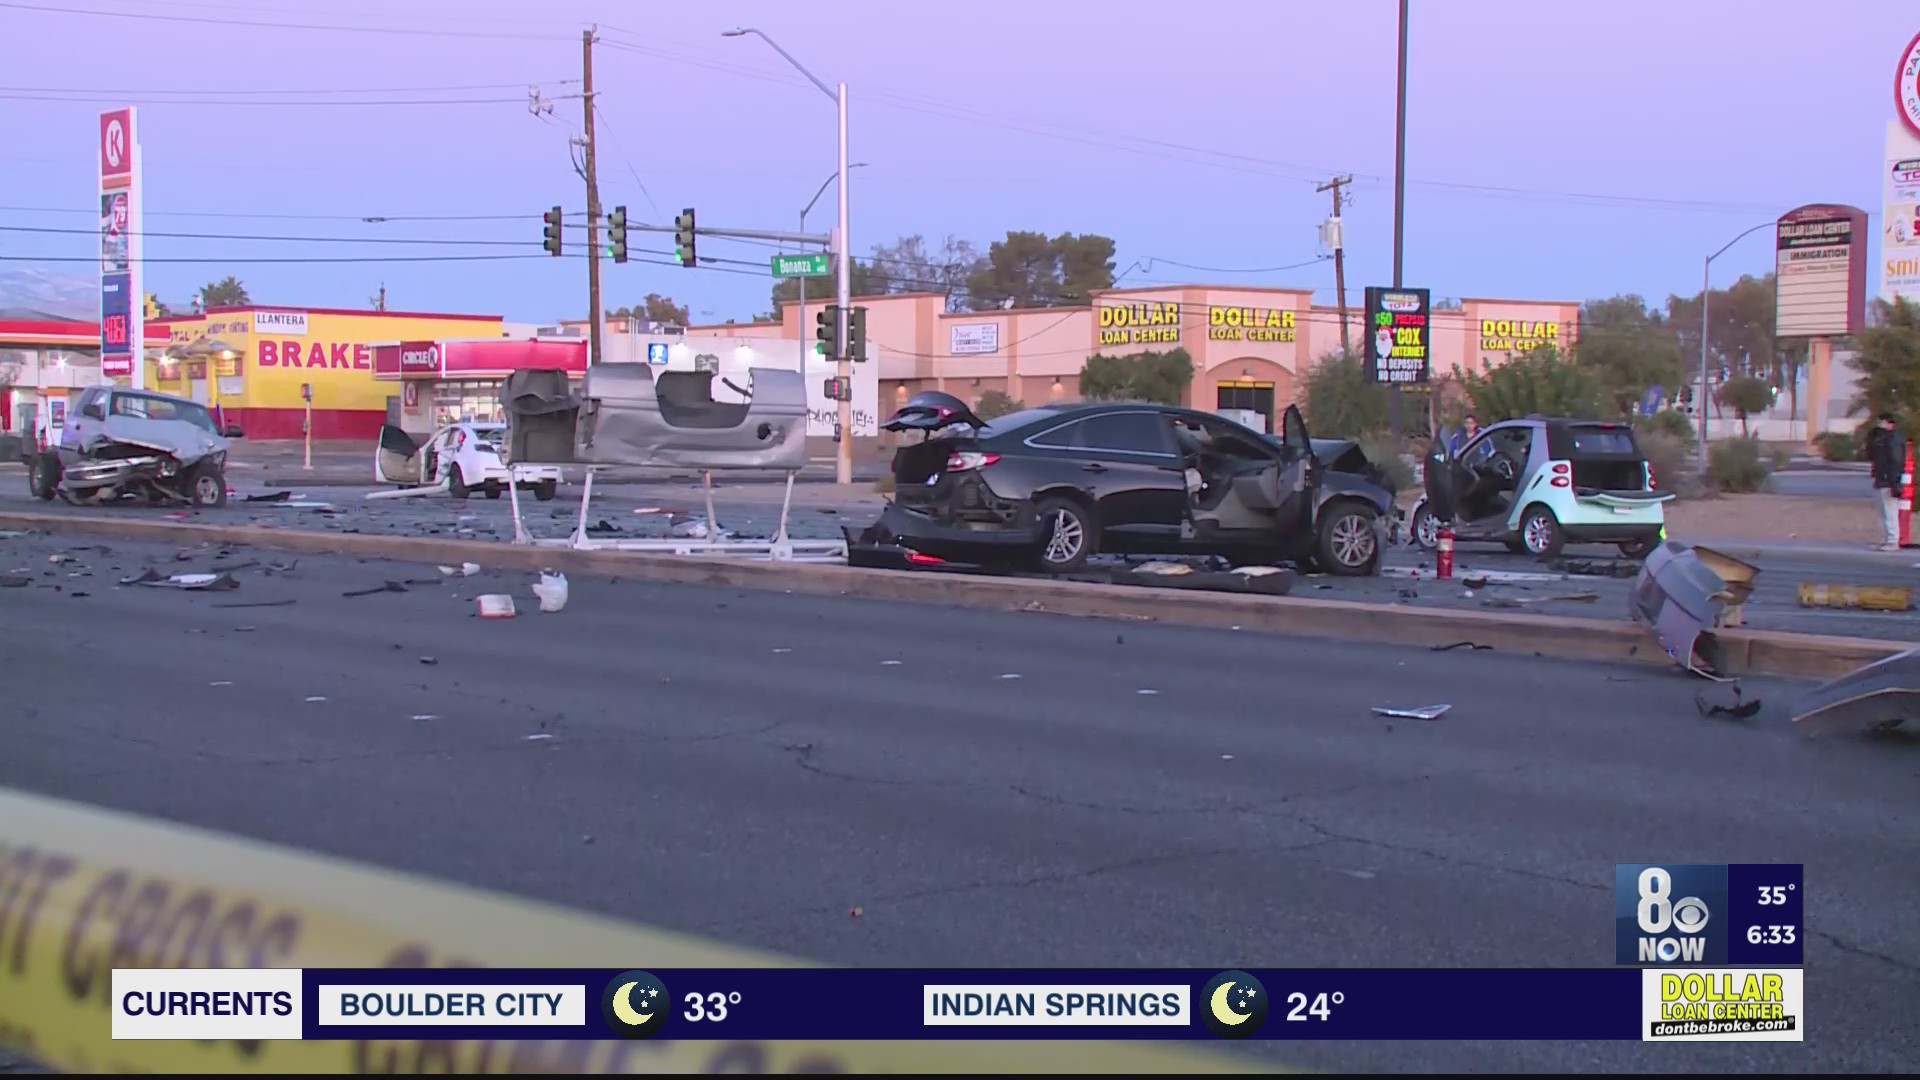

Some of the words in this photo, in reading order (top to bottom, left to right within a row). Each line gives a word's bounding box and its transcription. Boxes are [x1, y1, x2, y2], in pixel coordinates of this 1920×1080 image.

[1790, 249, 1847, 260] IMMIGRATION
[780, 259, 811, 273] Bonanza
[257, 314, 305, 325] LLANTERA
[1100, 303, 1179, 328] DOLLAR
[1209, 306, 1295, 328] DOLLAR
[1375, 312, 1392, 325] $50
[1209, 329, 1243, 340] LOAN
[1247, 329, 1296, 342] CENTER
[1481, 320, 1558, 338] DOLLAR
[1100, 330, 1129, 345] LOAN
[1133, 328, 1178, 343] CENTER
[1397, 327, 1420, 345] COX
[1481, 339, 1511, 350] LOAN
[259, 340, 371, 369] BRAKE
[402, 351, 428, 365] CIRCLE
[1392, 346, 1425, 358] INTERNET
[1377, 358, 1387, 370] NO
[1388, 358, 1423, 370] DEPOSITS
[1378, 370, 1388, 382] NO
[1390, 370, 1417, 382] CREDIT
